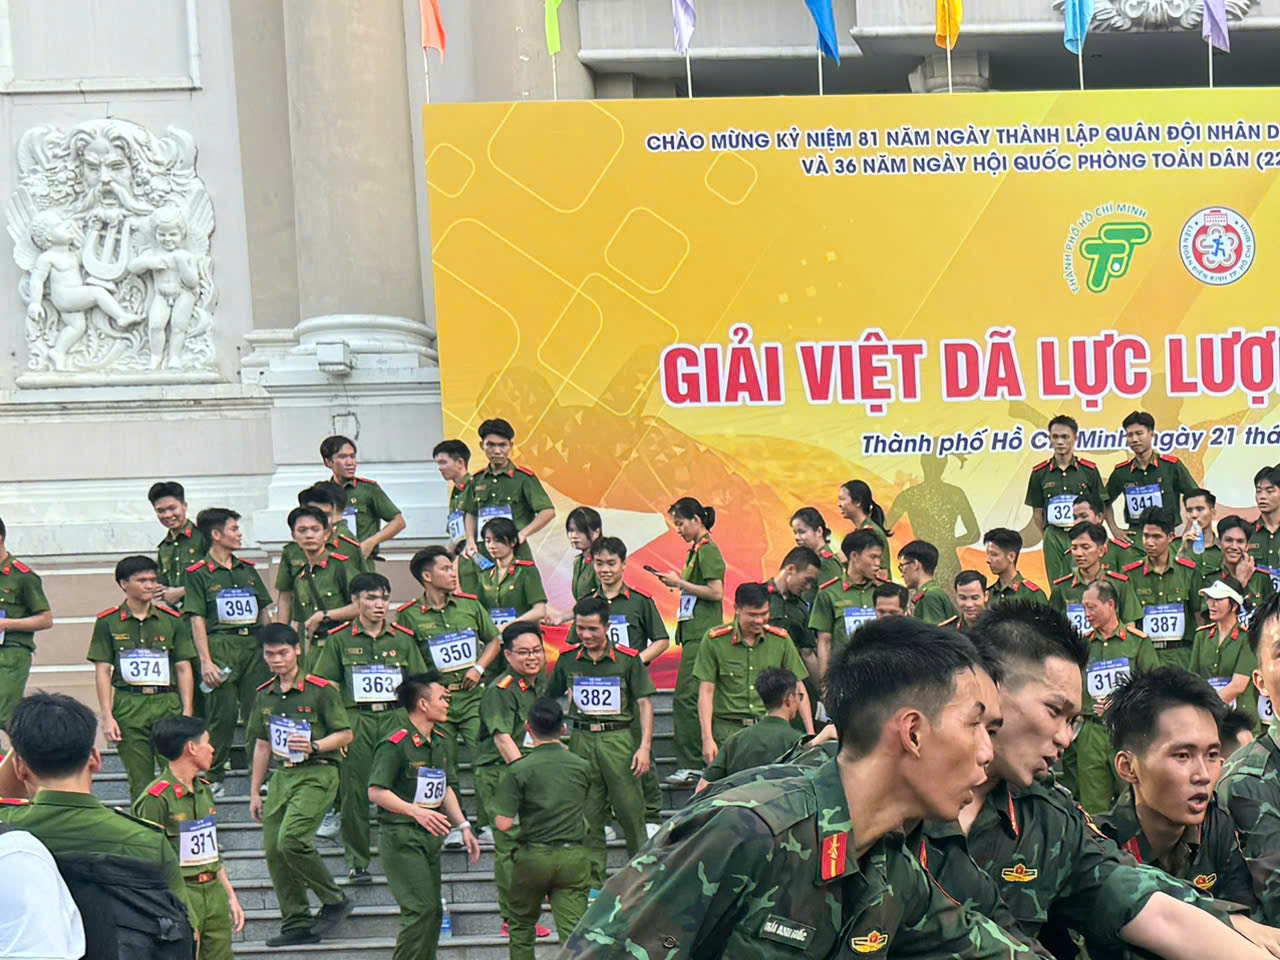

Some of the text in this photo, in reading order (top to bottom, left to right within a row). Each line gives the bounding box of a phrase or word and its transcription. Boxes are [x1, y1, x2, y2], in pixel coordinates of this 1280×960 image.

[646, 130, 705, 151] CHÀO
[711, 130, 770, 150] MỪNG
[776, 127, 801, 149] KỶ
[806, 128, 852, 151] NIỆM
[858, 131, 879, 147] 81
[887, 127, 930, 147] NĂM
[936, 125, 990, 146] NGÀY
[996, 124, 1060, 144] THÀNH
[1066, 123, 1100, 147] LẬP
[1105, 123, 1160, 142] QUÂN
[1167, 121, 1201, 145] ĐỘI
[1207, 121, 1261, 140] NHÂN
[801, 155, 829, 175] VÀ
[834, 158, 857, 174] 36
[862, 154, 906, 174] NĂM
[913, 153, 966, 173] NGÀY
[973, 152, 1007, 176] HỘI
[1013, 148, 1071, 170] QUỐC
[1078, 150, 1147, 170] PHÒNG
[1152, 148, 1202, 168] TOÀN
[1209, 148, 1249, 167] DÂN
[1116, 203, 1147, 217] MINH
[662, 327, 784, 404] GIẢI
[800, 331, 924, 413] VIỆT
[944, 329, 1023, 399] DÃ
[1040, 333, 1148, 409] LỰC
[862, 433, 931, 454] Thành
[939, 428, 988, 456] phố
[991, 427, 1023, 451] Hồ
[1209, 427, 1235, 446] 21
[1054, 504, 1071, 520] 32
[225, 599, 253, 617] 394
[1150, 615, 1178, 633] 387
[439, 641, 472, 664] 350
[129, 660, 161, 677] 374
[362, 676, 394, 693] 363
[580, 688, 612, 706] 382
[190, 829, 216, 855] 371
